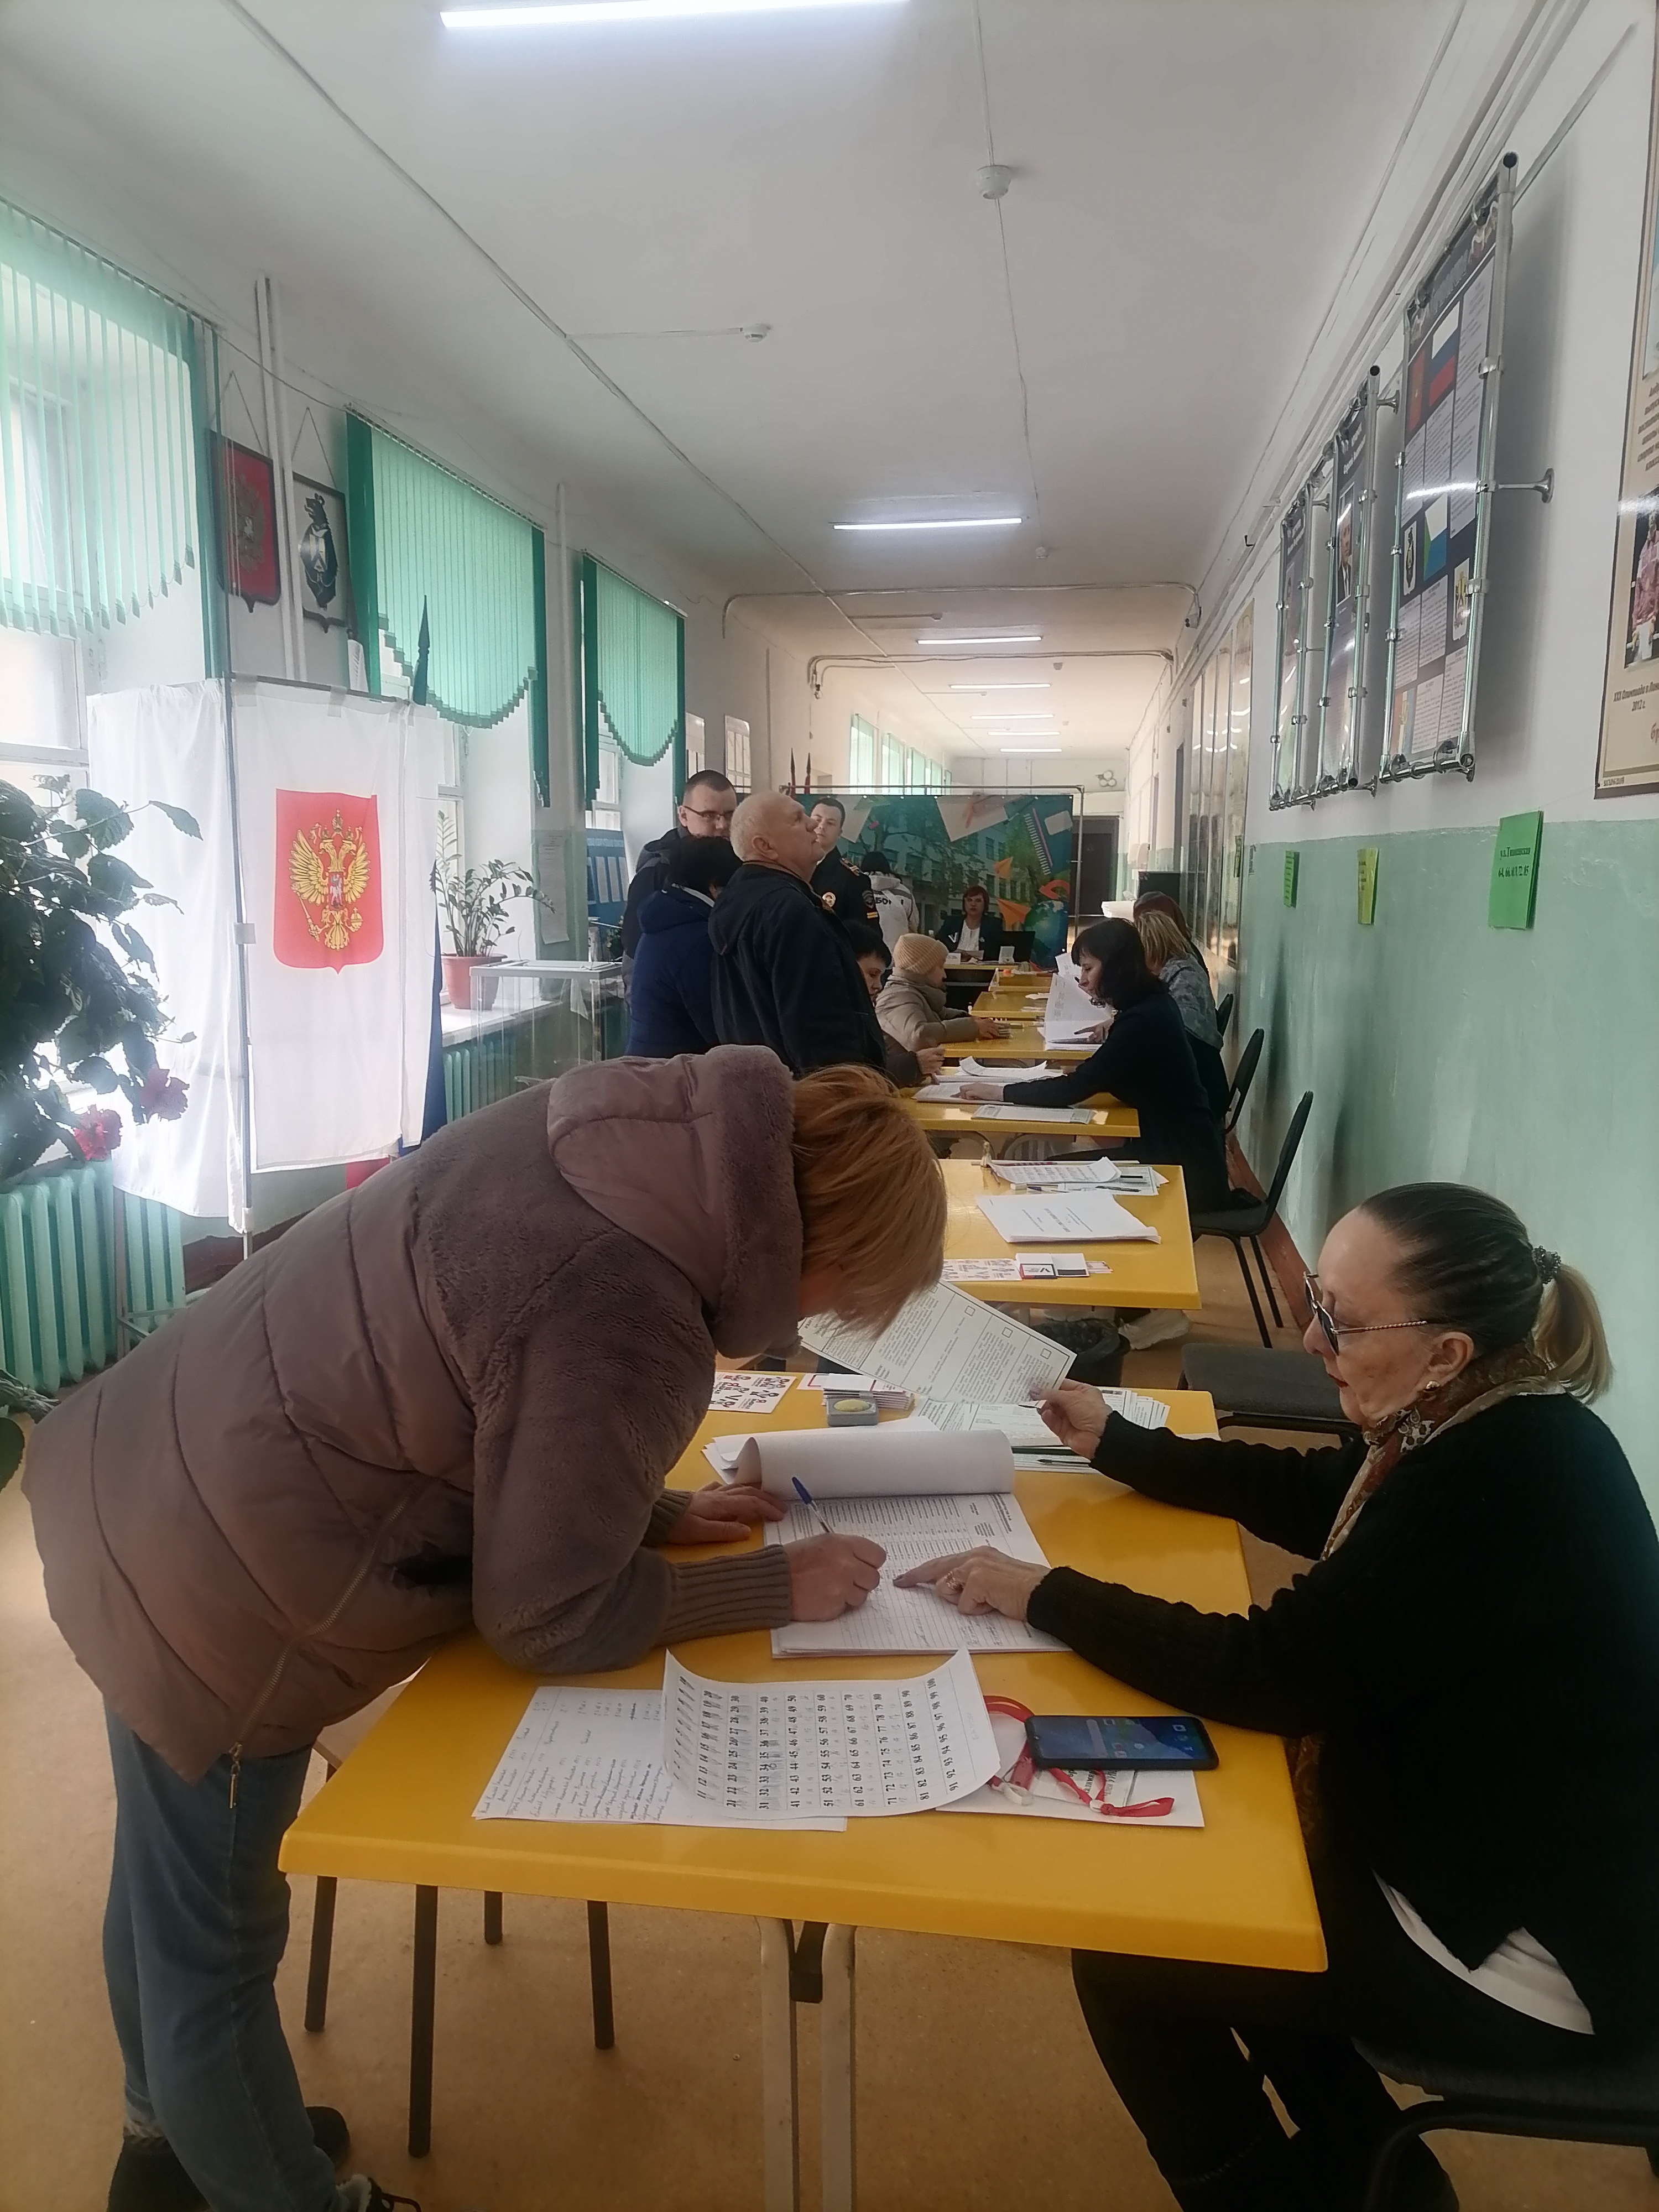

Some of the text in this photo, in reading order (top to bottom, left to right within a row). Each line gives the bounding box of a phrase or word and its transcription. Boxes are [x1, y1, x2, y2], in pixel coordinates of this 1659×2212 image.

[927, 1678, 936, 1689] 100
[932, 1701, 941, 1710] 98
[936, 1723, 946, 1731] 96
[909, 1732, 919, 1740] 86
[938, 1734, 948, 1743] 95
[700, 1742, 709, 1751] 15
[911, 1744, 921, 1752] 85
[941, 1745, 951, 1754] 94
[699, 1754, 708, 1762] 14
[943, 1757, 953, 1766] 93
[698, 1765, 708, 1774] 13
[946, 1768, 956, 1778] 92
[698, 1777, 707, 1786] 12
[917, 1779, 927, 1787] 82
[885, 1783, 895, 1792] 72
[949, 1782, 959, 1792] 91
[697, 1790, 707, 1799] 11
[919, 1792, 930, 1801] 81
